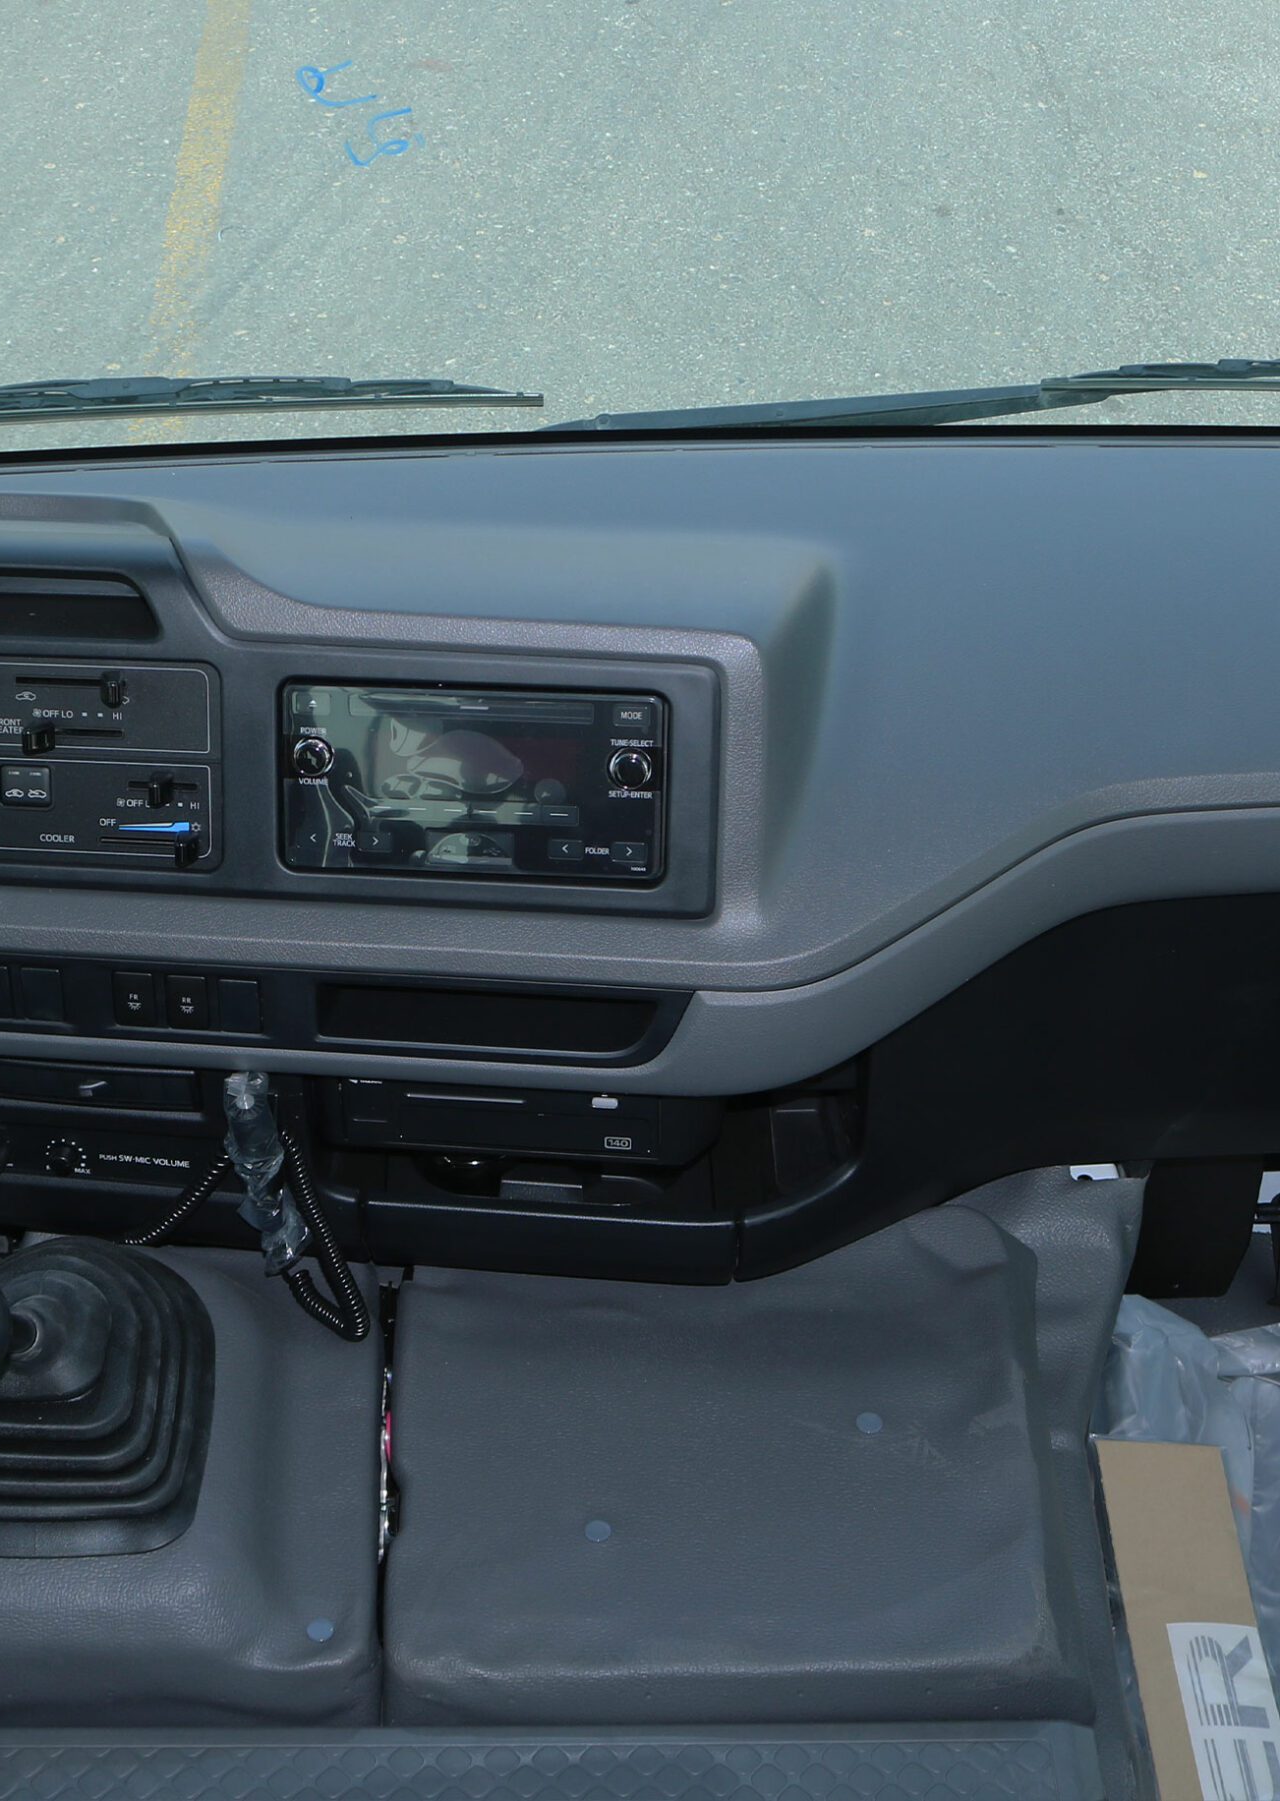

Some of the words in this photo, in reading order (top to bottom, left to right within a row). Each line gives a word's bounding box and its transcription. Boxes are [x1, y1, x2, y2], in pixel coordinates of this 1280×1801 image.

[42, 709, 59, 718] OFF
[61, 710, 74, 719] LO
[112, 712, 122, 720] HI
[620, 711, 643, 720] MODE
[300, 726, 327, 735] POWER
[298, 777, 328, 785] VOLUME
[126, 799, 144, 808] OFF
[190, 801, 200, 810] HI
[99, 818, 117, 827] OFF
[39, 833, 75, 843] COOLER
[335, 833, 353, 841] SEEK
[332, 839, 356, 847] TRACK
[584, 846, 610, 855] FOLDER
[607, 1139, 629, 1147] 140
[98, 1153, 118, 1162] PUSH
[152, 1157, 191, 1169] VOLUME
[74, 1167, 91, 1175] MAX
